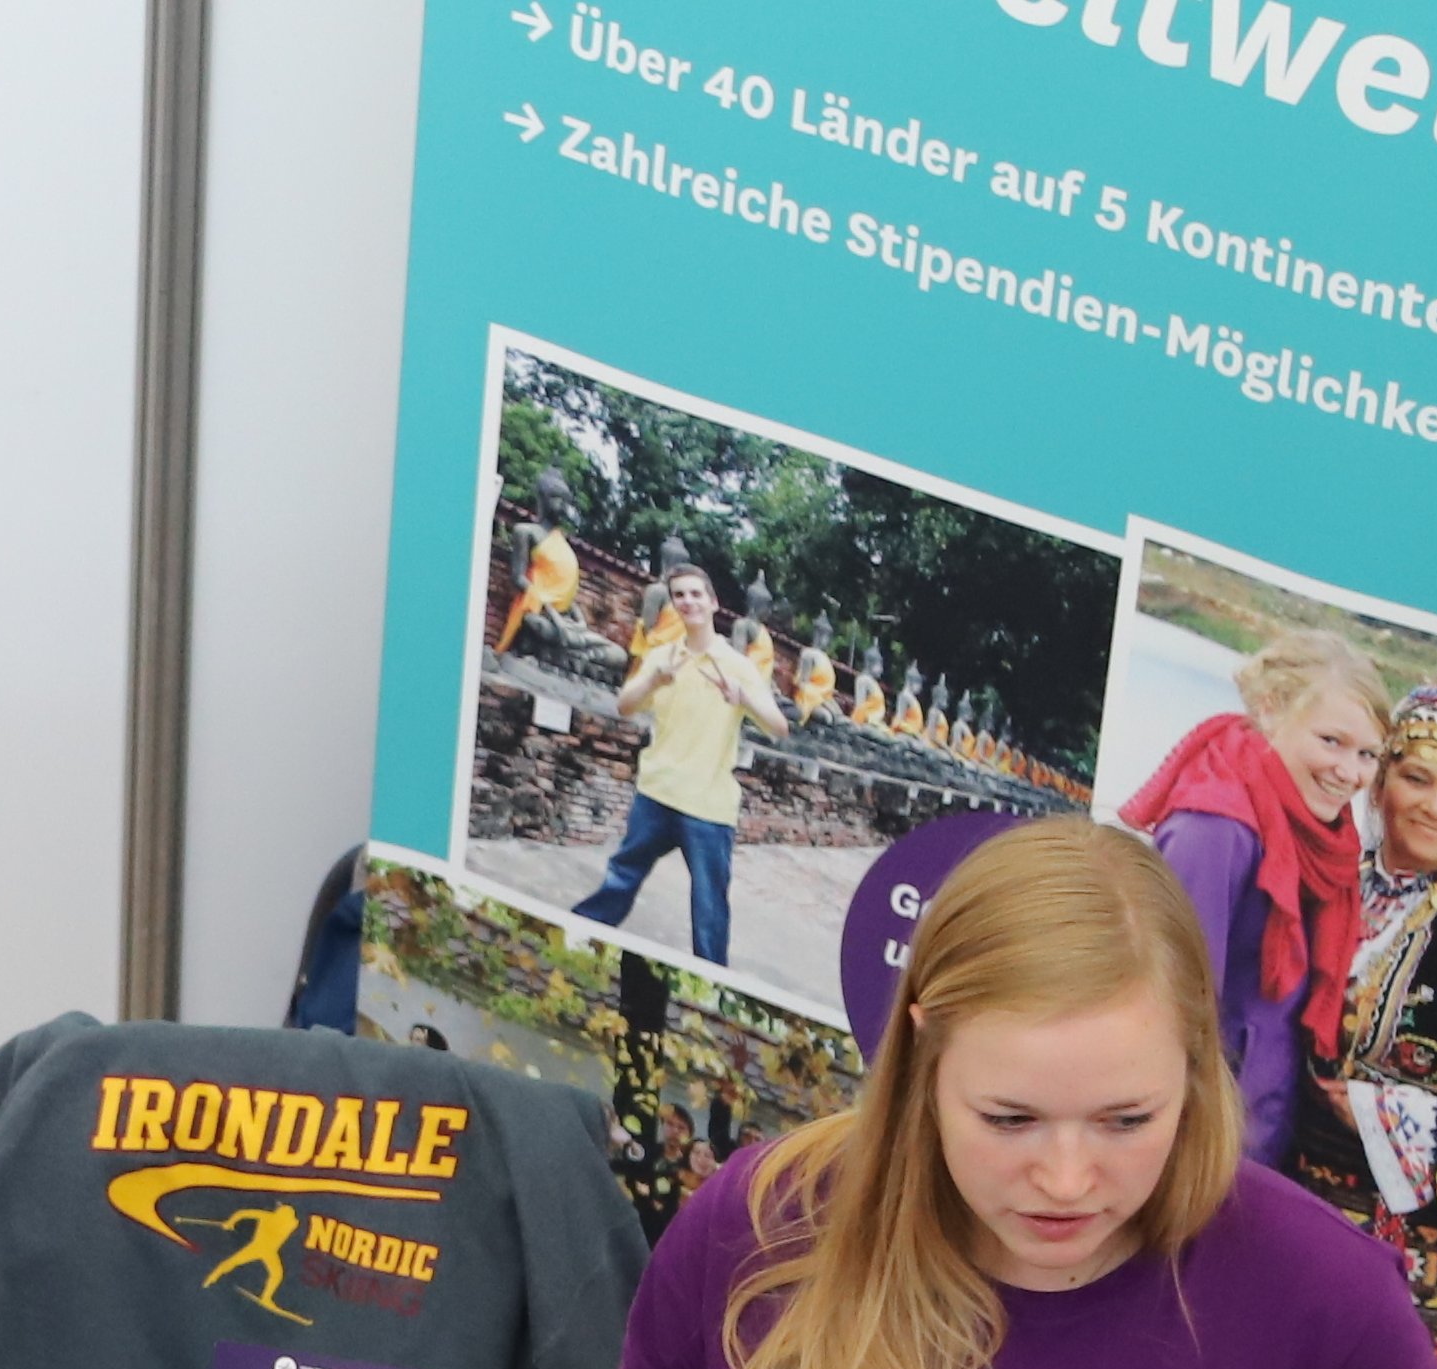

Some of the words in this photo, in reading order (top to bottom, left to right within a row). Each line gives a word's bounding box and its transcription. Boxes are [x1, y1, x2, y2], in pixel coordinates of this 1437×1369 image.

[558, 114, 833, 243] Zahlreiche
[570, 10, 690, 91] Über
[704, 63, 773, 119] 40
[791, 88, 978, 182] Länder
[991, 155, 1084, 226] auf
[1093, 187, 1129, 233] 5
[91, 1075, 468, 1178] IRONDALE
[304, 1215, 440, 1282] NORDIC
